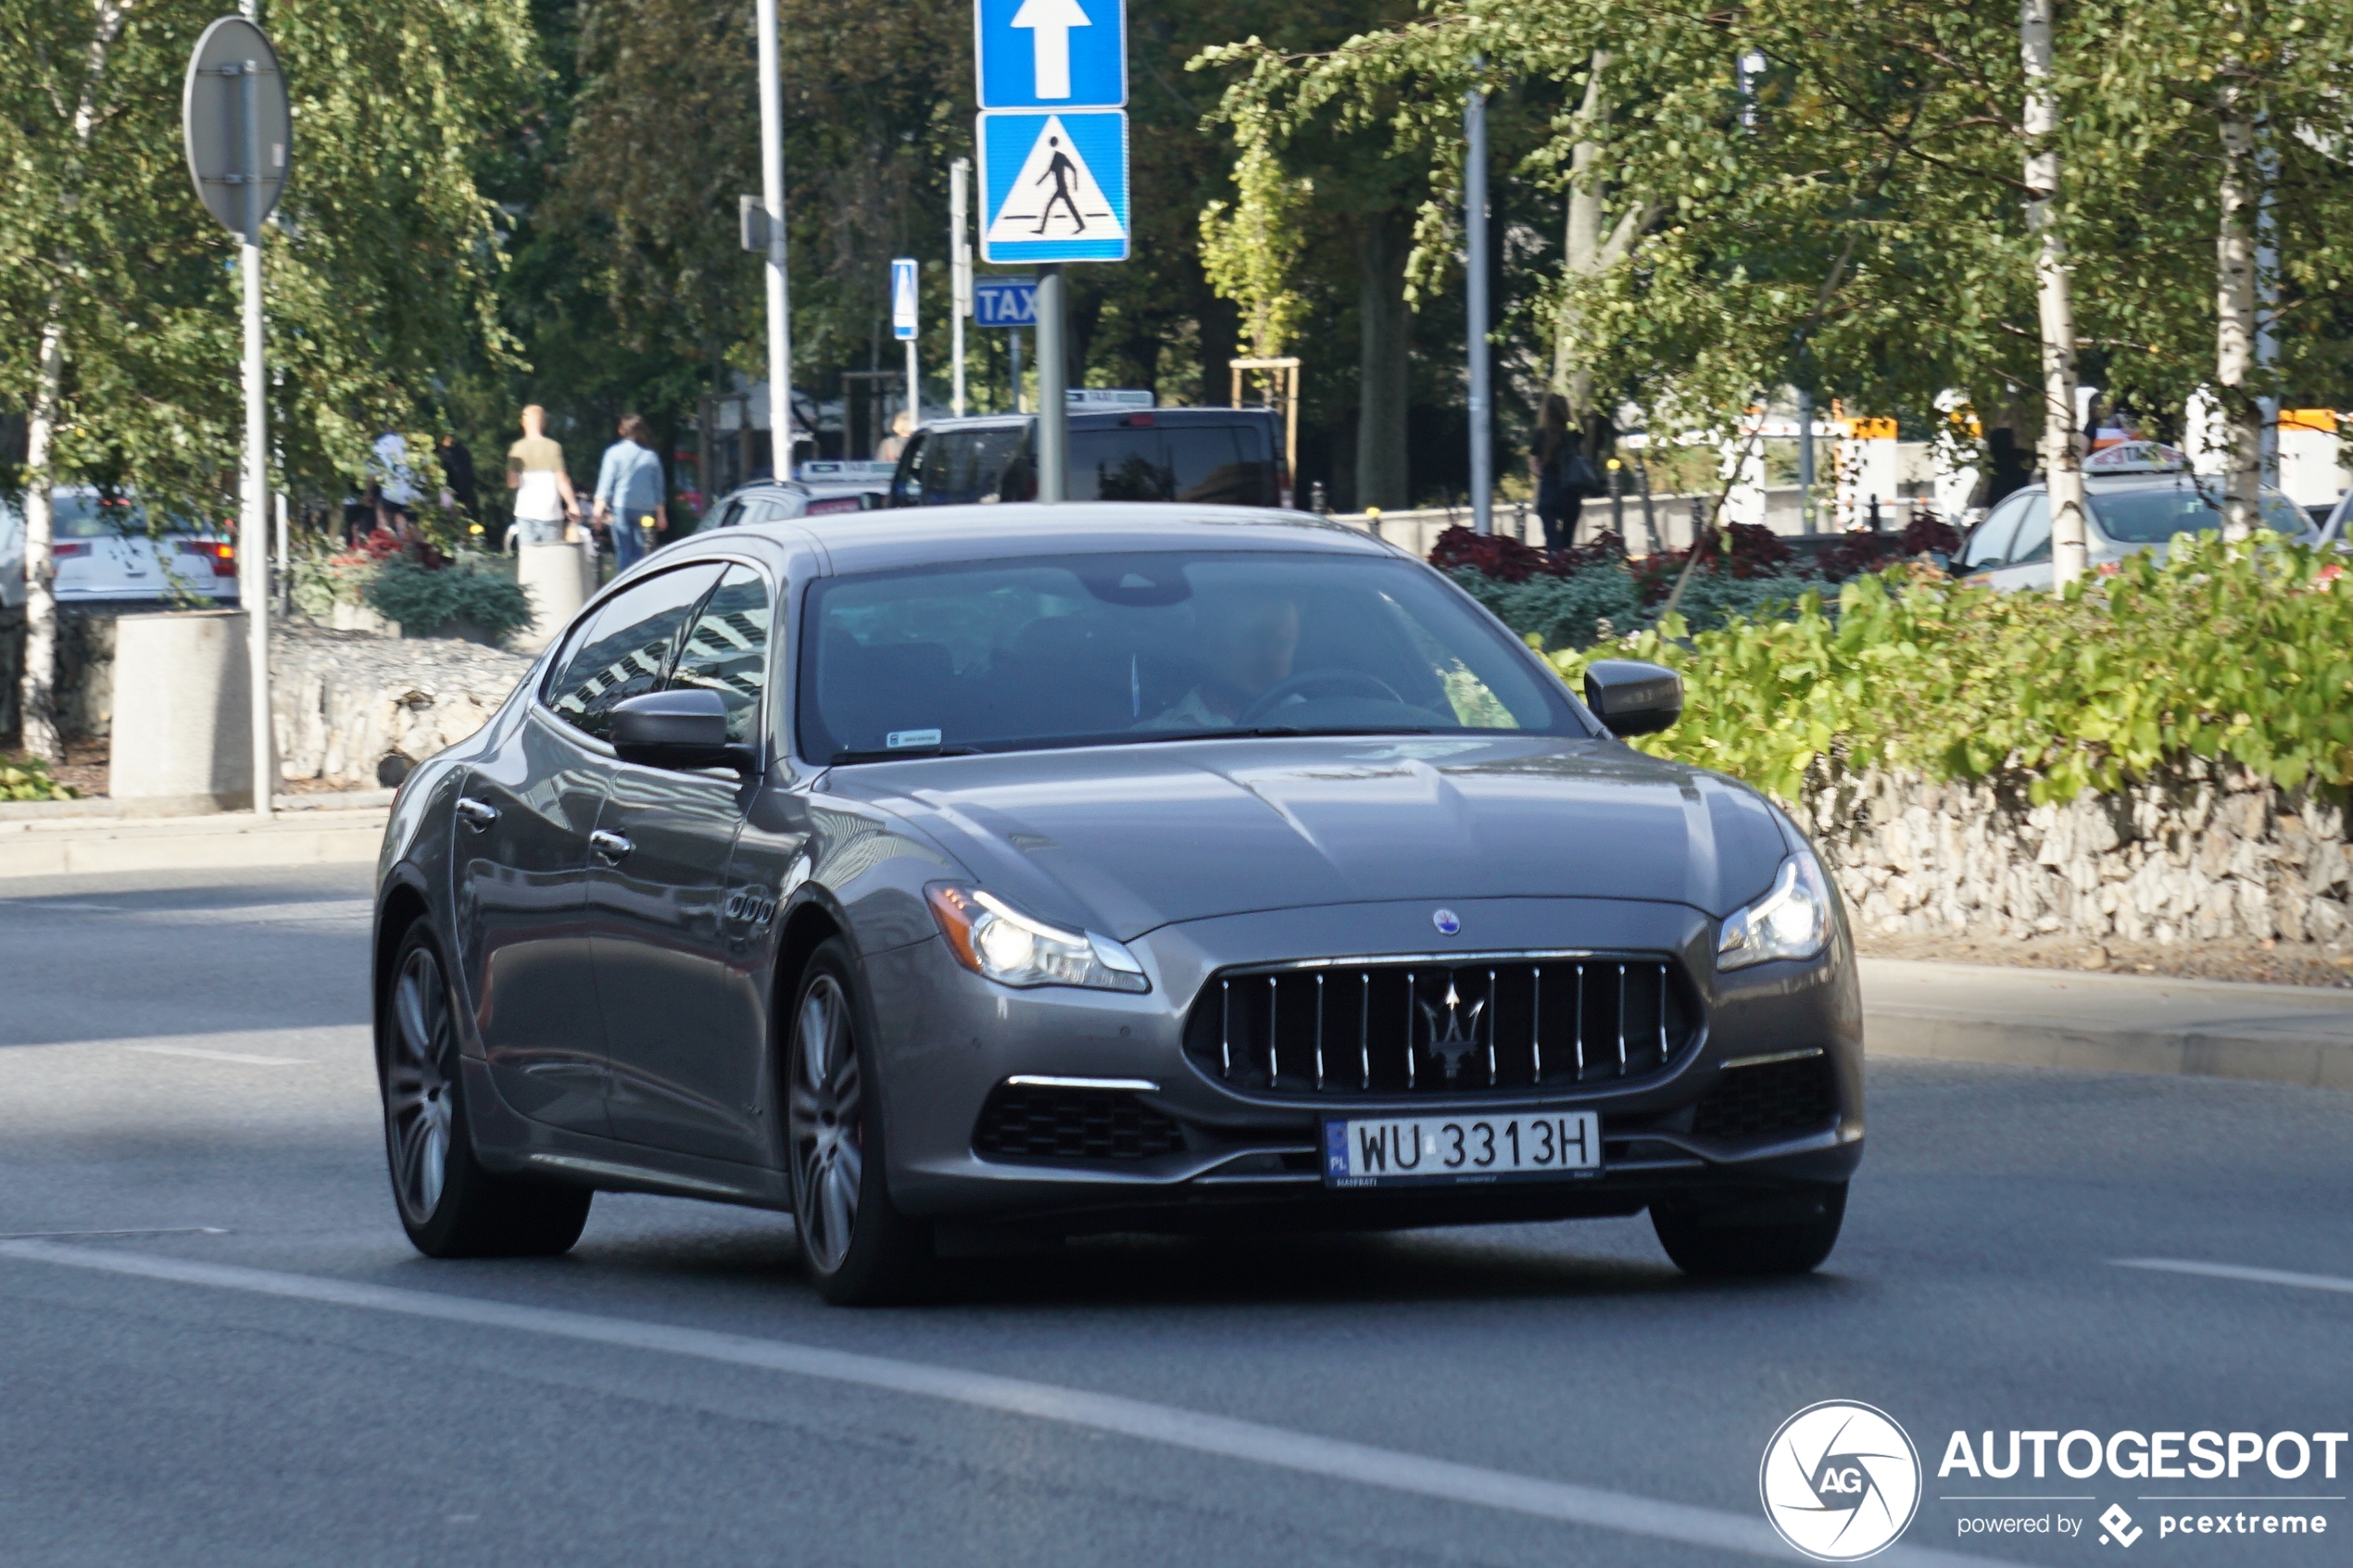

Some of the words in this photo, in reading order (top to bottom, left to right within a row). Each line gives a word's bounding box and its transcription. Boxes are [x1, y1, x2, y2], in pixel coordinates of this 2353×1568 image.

[977, 289, 1038, 321] TAX
[1359, 1124, 1421, 1173] WU
[1441, 1118, 1588, 1168] 3313H
[1329, 1156, 1348, 1172] PL
